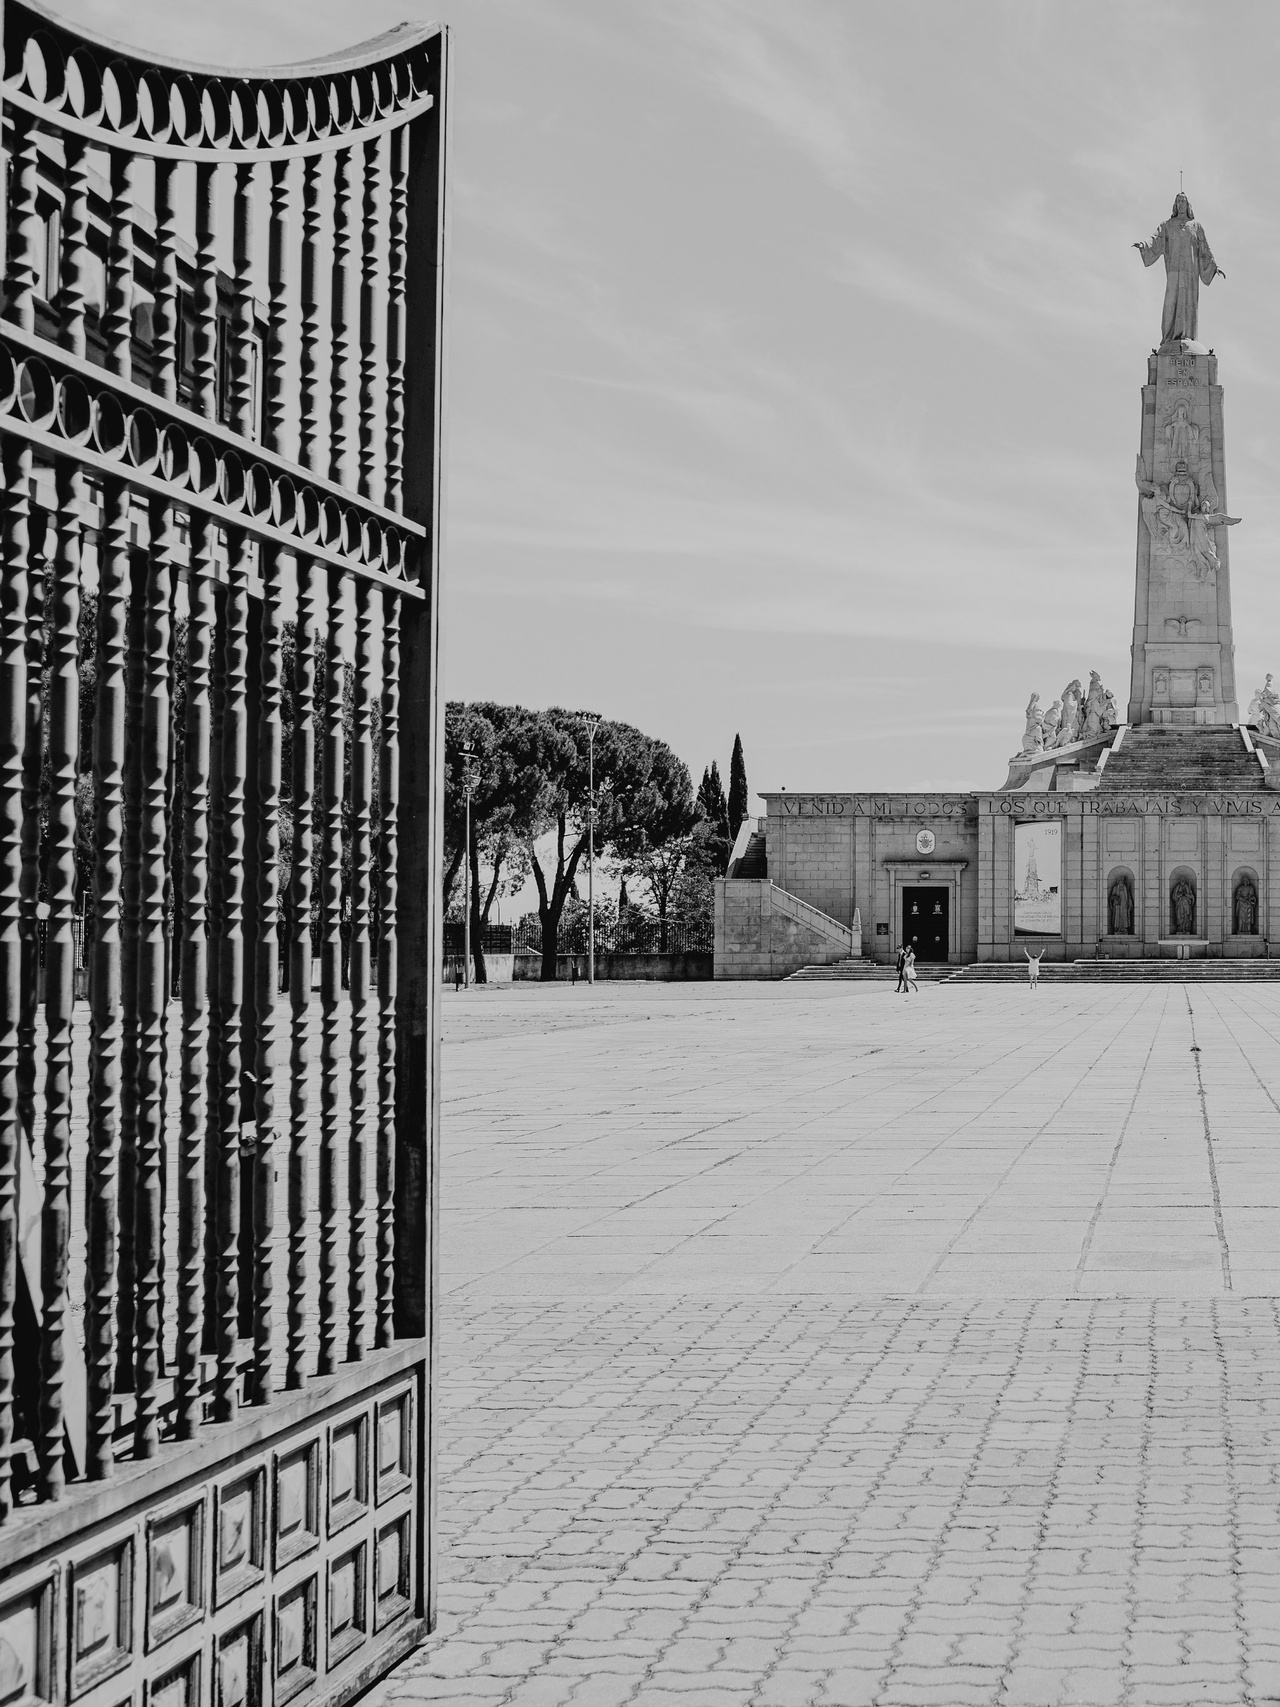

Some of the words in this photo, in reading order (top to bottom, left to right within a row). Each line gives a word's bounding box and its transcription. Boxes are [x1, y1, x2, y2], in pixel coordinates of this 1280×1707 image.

[1170, 359, 1195, 367] REINO
[783, 802, 845, 815] VENID
[852, 802, 866, 815] A
[873, 802, 893, 815] MI
[902, 802, 968, 815] TODOS
[988, 801, 1025, 814] LOS
[1033, 801, 1068, 814] QUE
[1078, 801, 1182, 814] TRABAJAIS
[1191, 801, 1203, 814] Y
[1213, 801, 1263, 814] VIVIS
